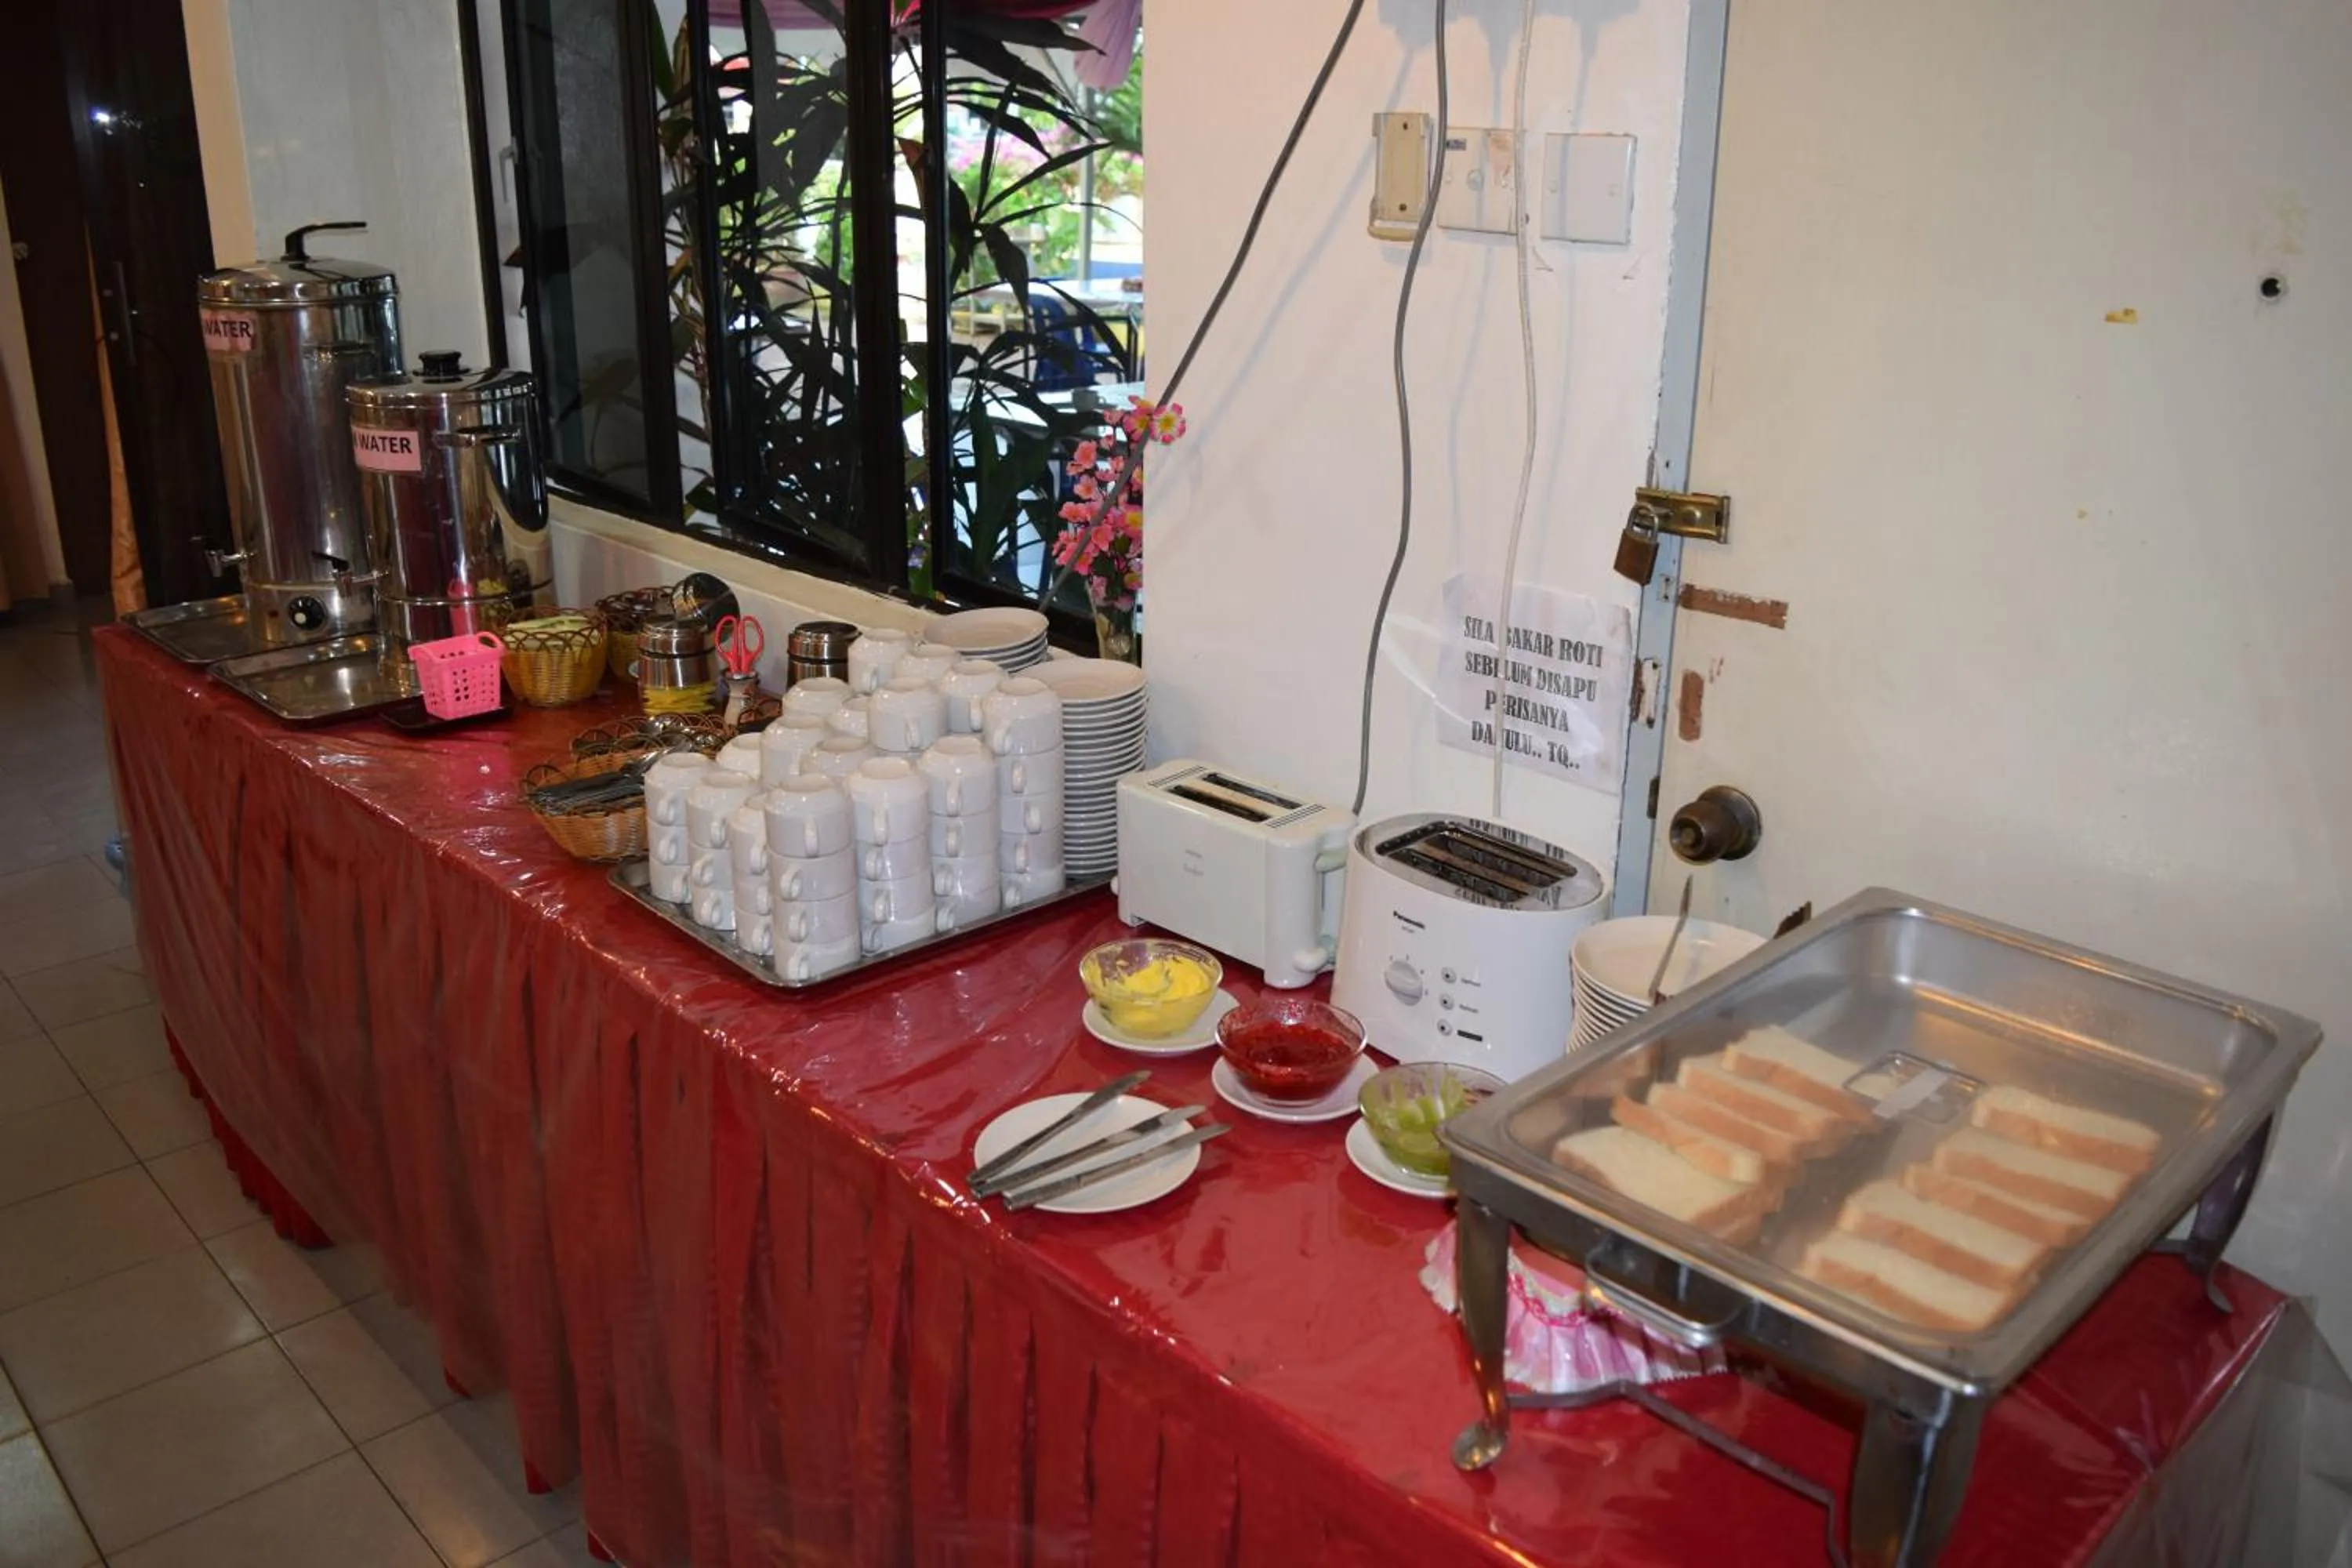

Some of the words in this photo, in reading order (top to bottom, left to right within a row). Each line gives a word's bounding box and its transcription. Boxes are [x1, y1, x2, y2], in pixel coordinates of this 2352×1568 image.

[358, 432, 412, 454] WATER
[1464, 615, 1494, 644] SILA
[1559, 637, 1603, 668] ROTI
[1535, 667, 1597, 702] DISAPU
[1485, 689, 1569, 732] PRISANYA
[1472, 720, 1541, 758] DAULU..
